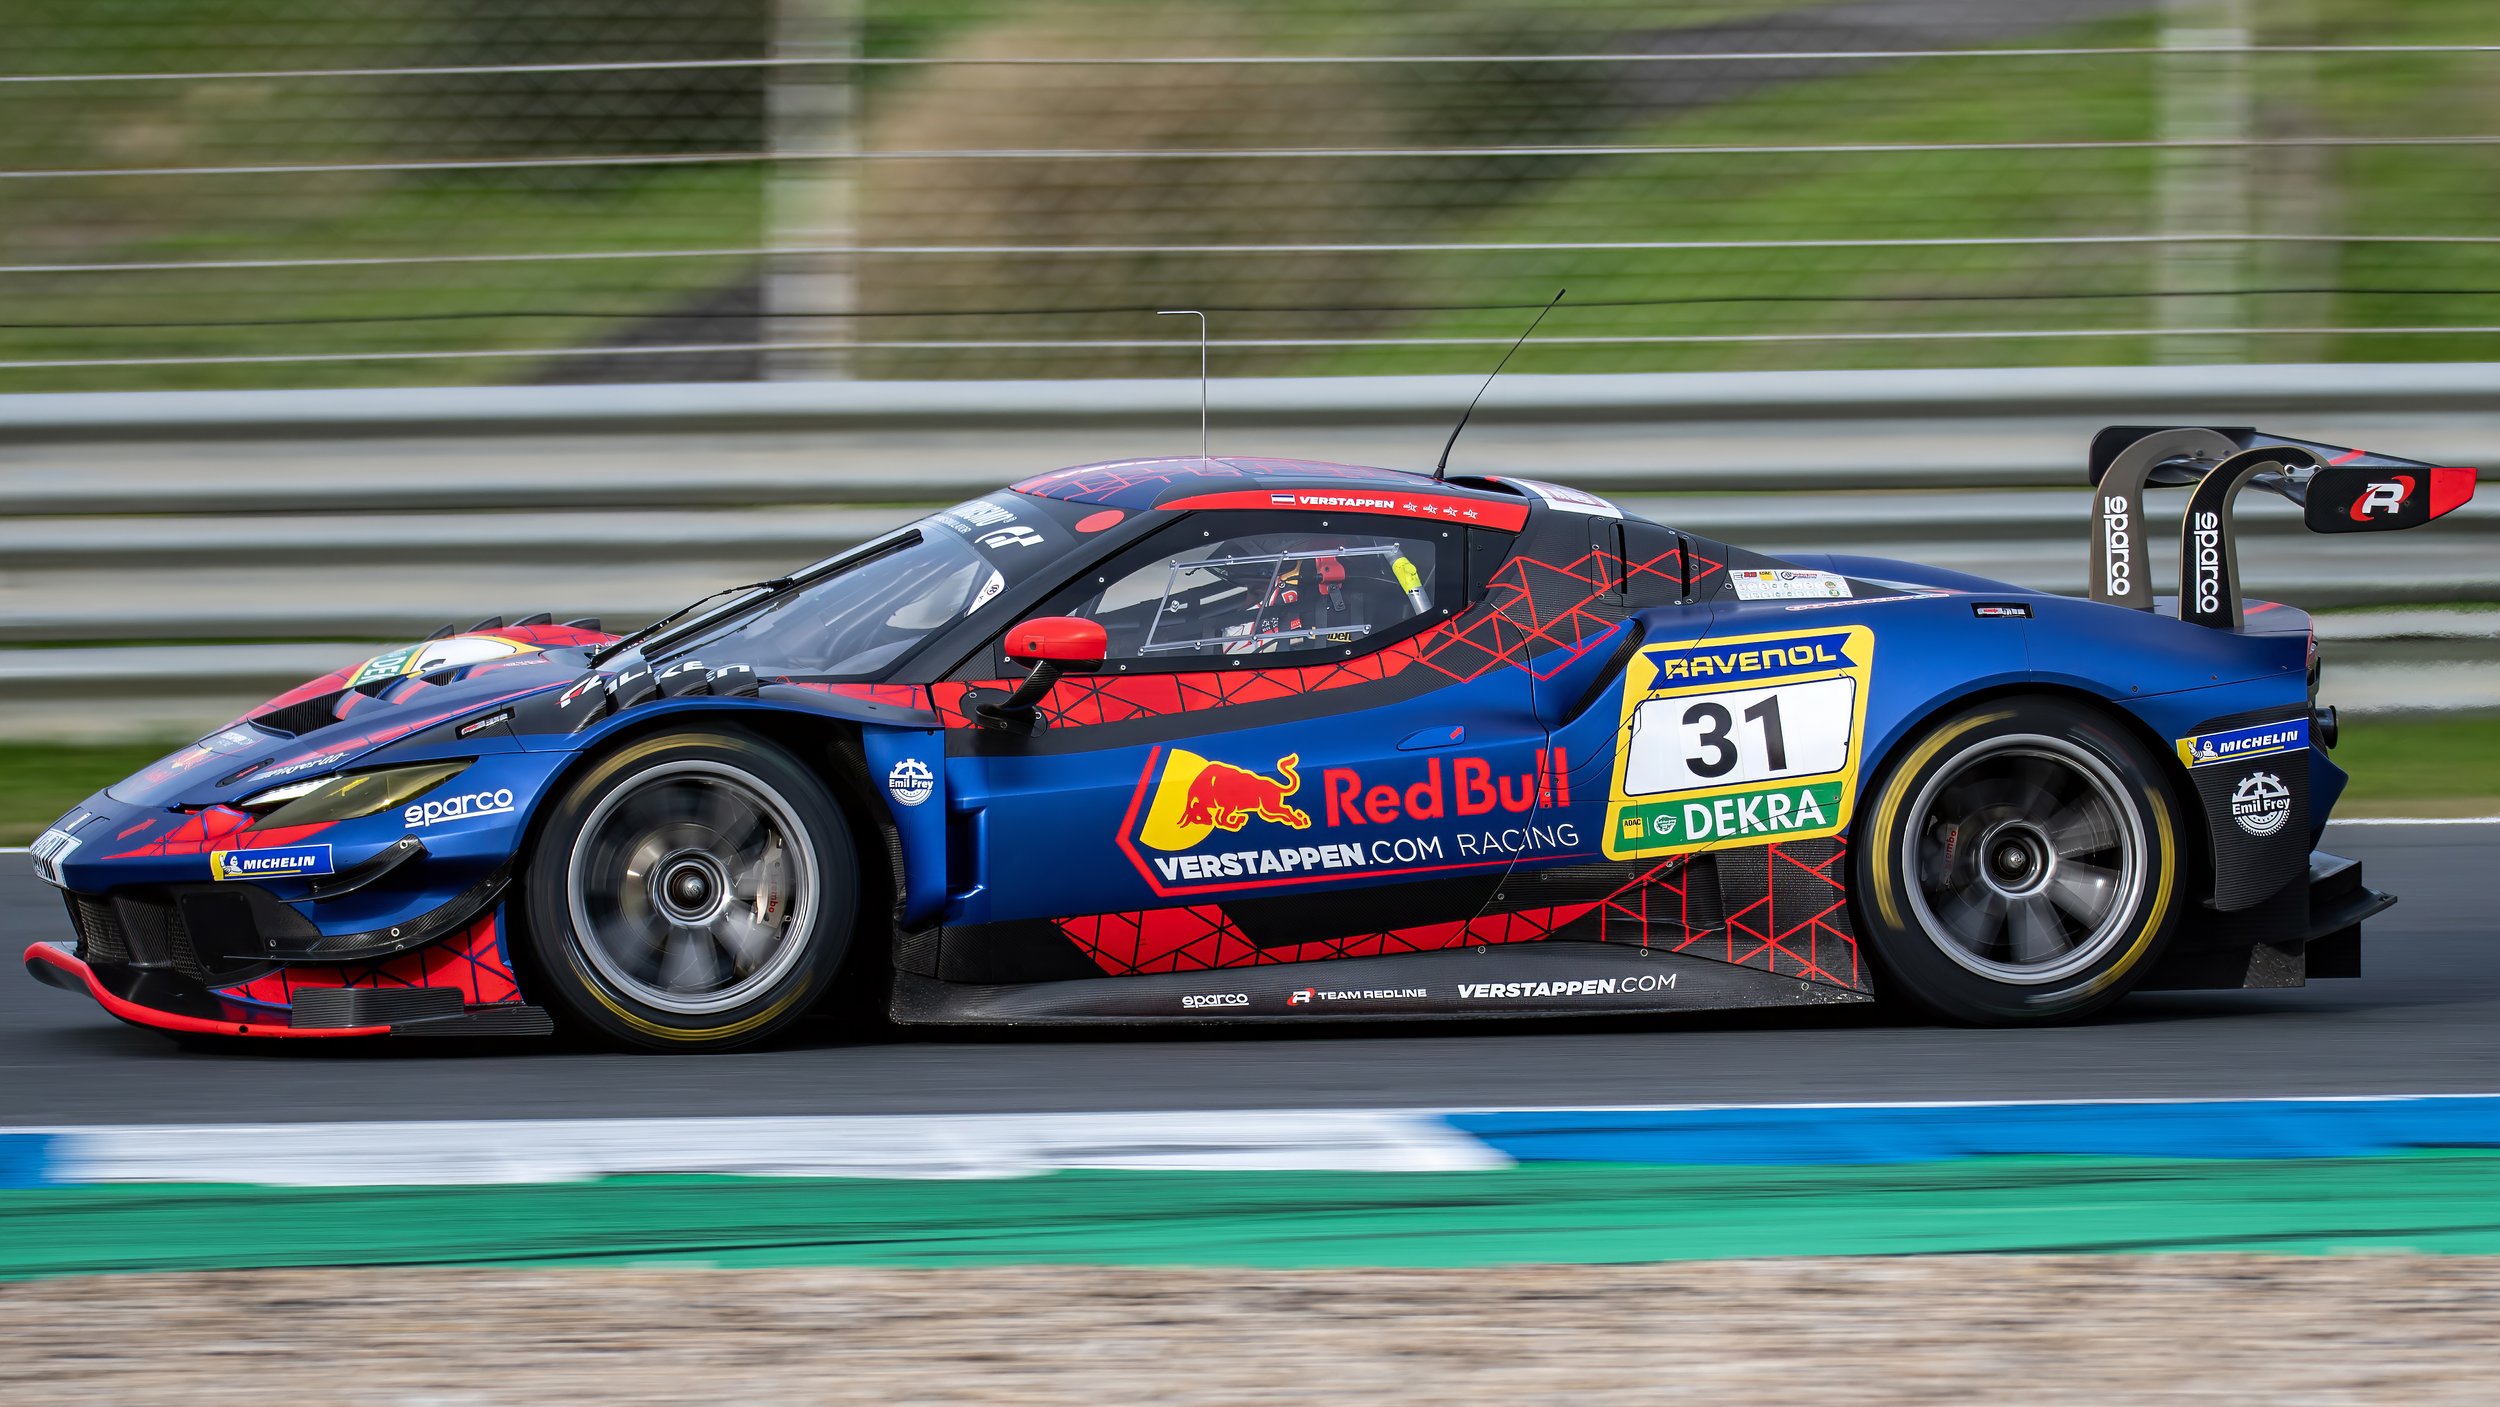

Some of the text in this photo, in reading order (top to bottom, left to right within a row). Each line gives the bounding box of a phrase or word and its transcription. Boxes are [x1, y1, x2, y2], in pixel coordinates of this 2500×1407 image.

[1299, 496, 1395, 509] VERSTAPPEN
[2103, 495, 2131, 596] sparco
[2193, 511, 2219, 614] sparco
[1664, 644, 1837, 680] RAVENOL
[1682, 694, 1787, 778] 31
[2220, 730, 2299, 753] MICHELIN
[889, 778, 934, 790] Emil Frey
[1323, 747, 1571, 828] Red Bull
[403, 788, 515, 829] sparco
[1683, 789, 1827, 841] DEKRA
[2232, 797, 2291, 815] Emil Frey
[1624, 818, 1642, 827] ADAC
[243, 855, 316, 870] MICHELIN
[1154, 823, 1580, 881] VERSTAPPEN.COM RACING
[1318, 990, 1361, 1001] TEAM
[1363, 988, 1427, 999] REDLINE
[1457, 973, 1677, 999] VERSTAPPEN.COM
[1182, 993, 1250, 1009] sparco
